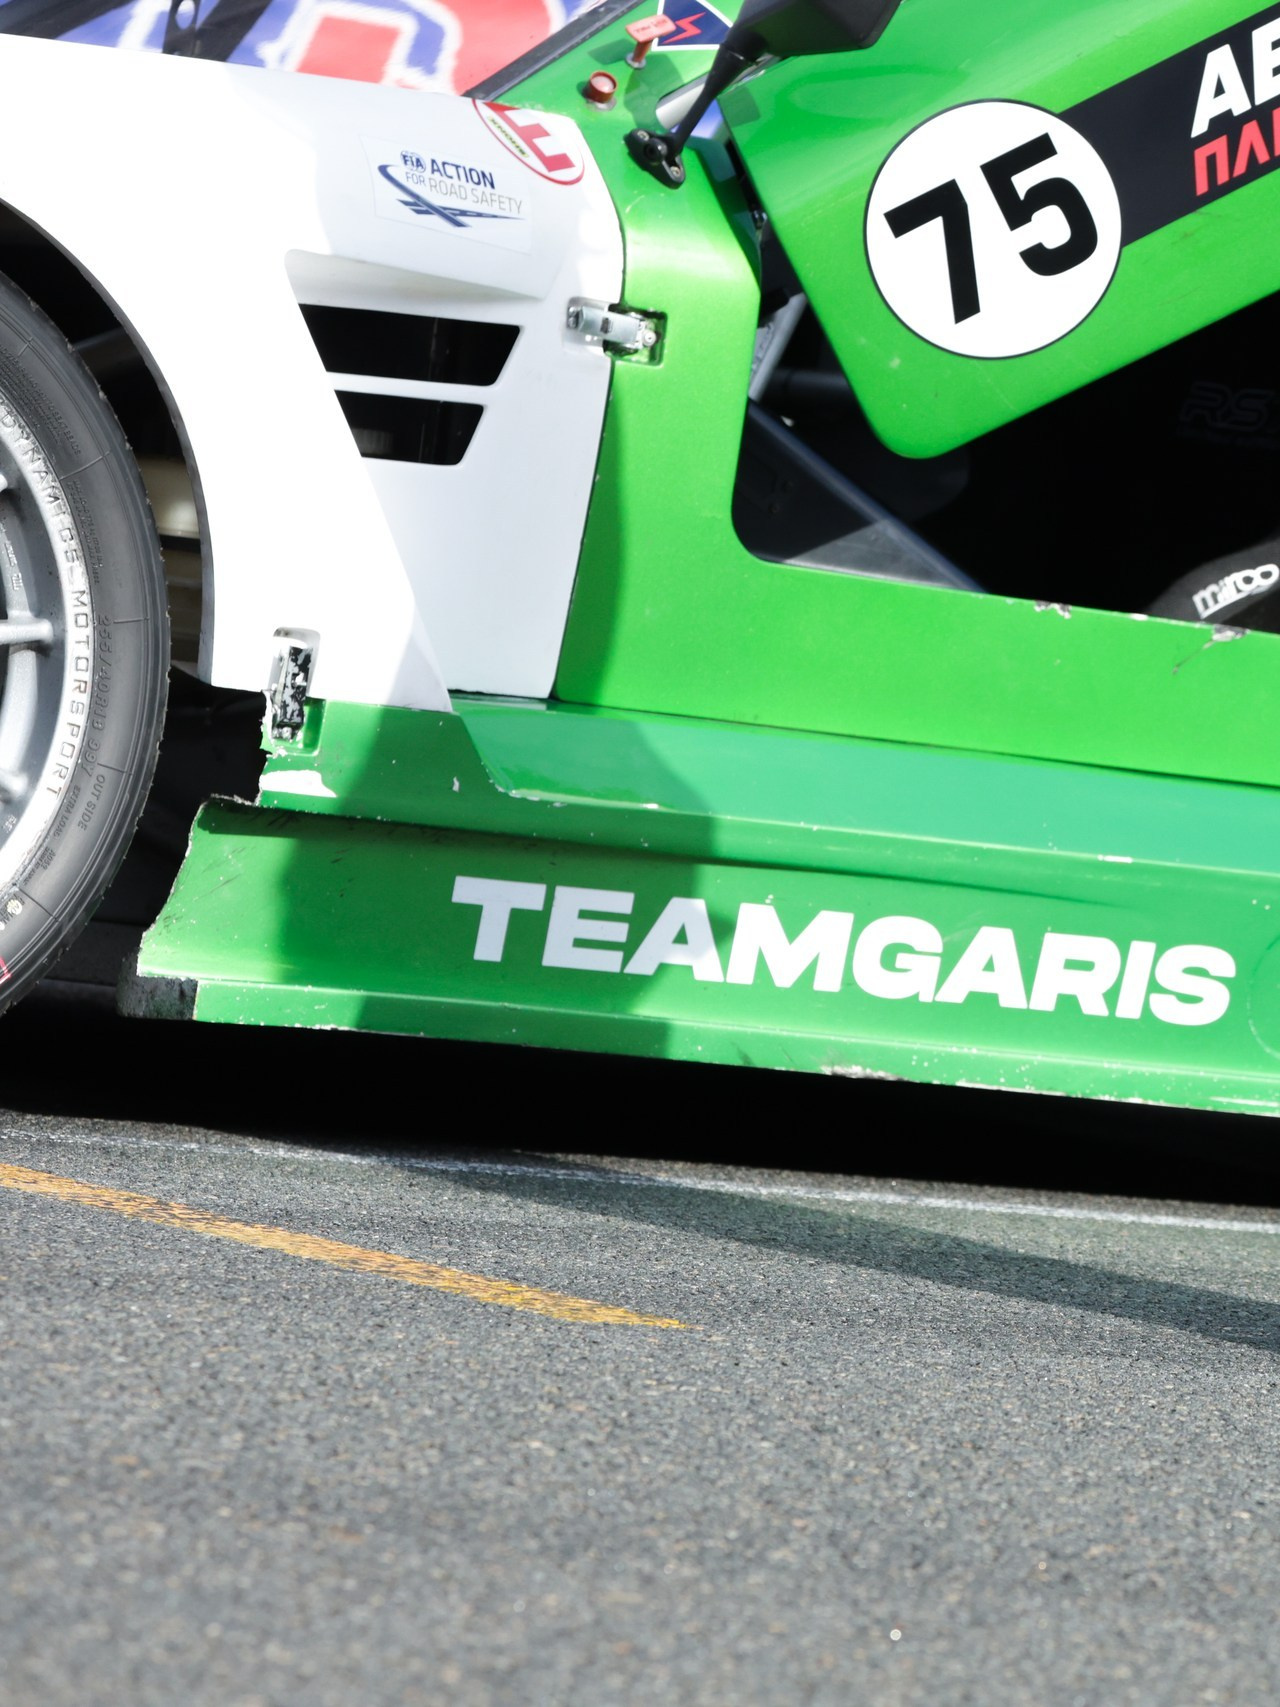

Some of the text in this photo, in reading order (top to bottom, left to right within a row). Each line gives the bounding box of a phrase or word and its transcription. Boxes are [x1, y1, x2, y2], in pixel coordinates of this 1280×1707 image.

[405, 172, 522, 215] FOR ROAD SAFETY
[431, 158, 495, 190] ACTION
[883, 131, 1099, 324] 75
[47, 589, 90, 801] MOTORSPORT
[78, 801, 96, 831] SIDE
[452, 875, 1237, 1027] TEAMGARIS
